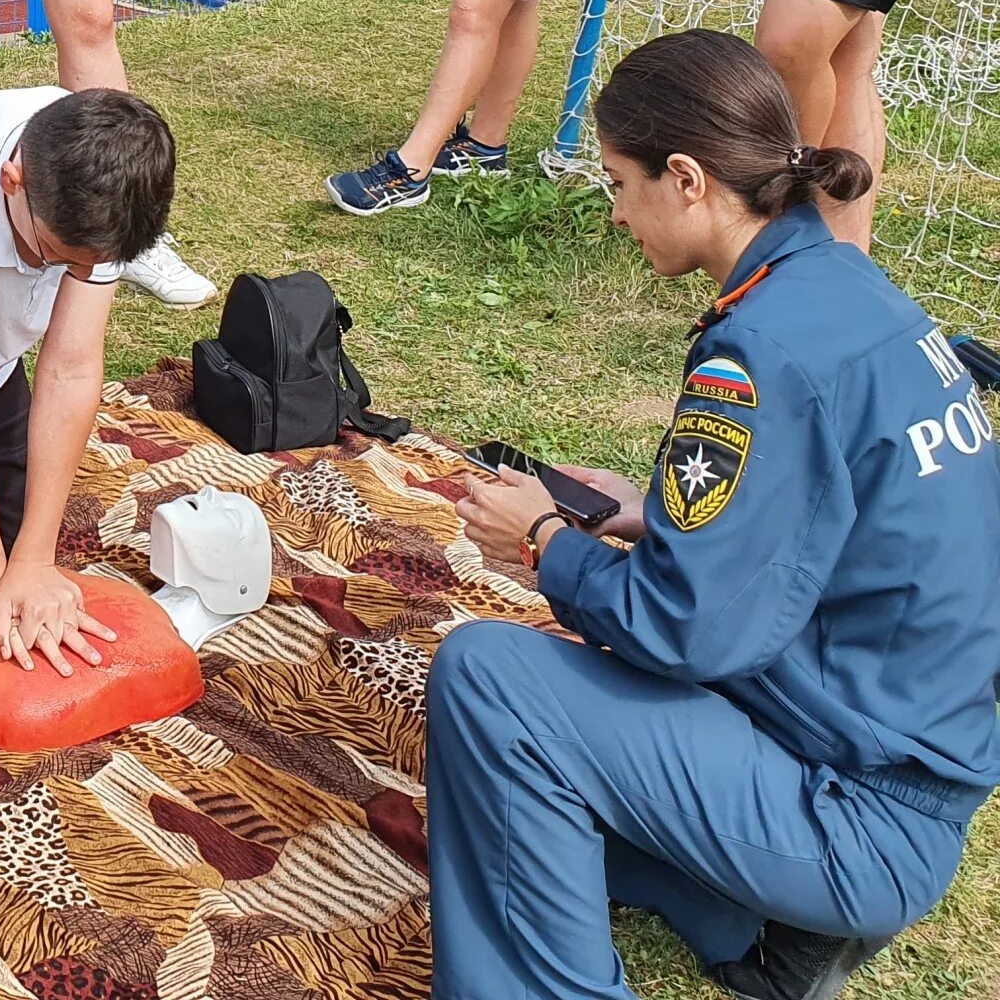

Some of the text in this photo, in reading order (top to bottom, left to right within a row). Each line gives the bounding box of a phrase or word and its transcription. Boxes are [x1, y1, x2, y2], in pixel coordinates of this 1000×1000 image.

[694, 383, 738, 400] RUSSIA
[677, 416, 746, 447] МЧС РОССИИ
[906, 382, 992, 478] РОС
